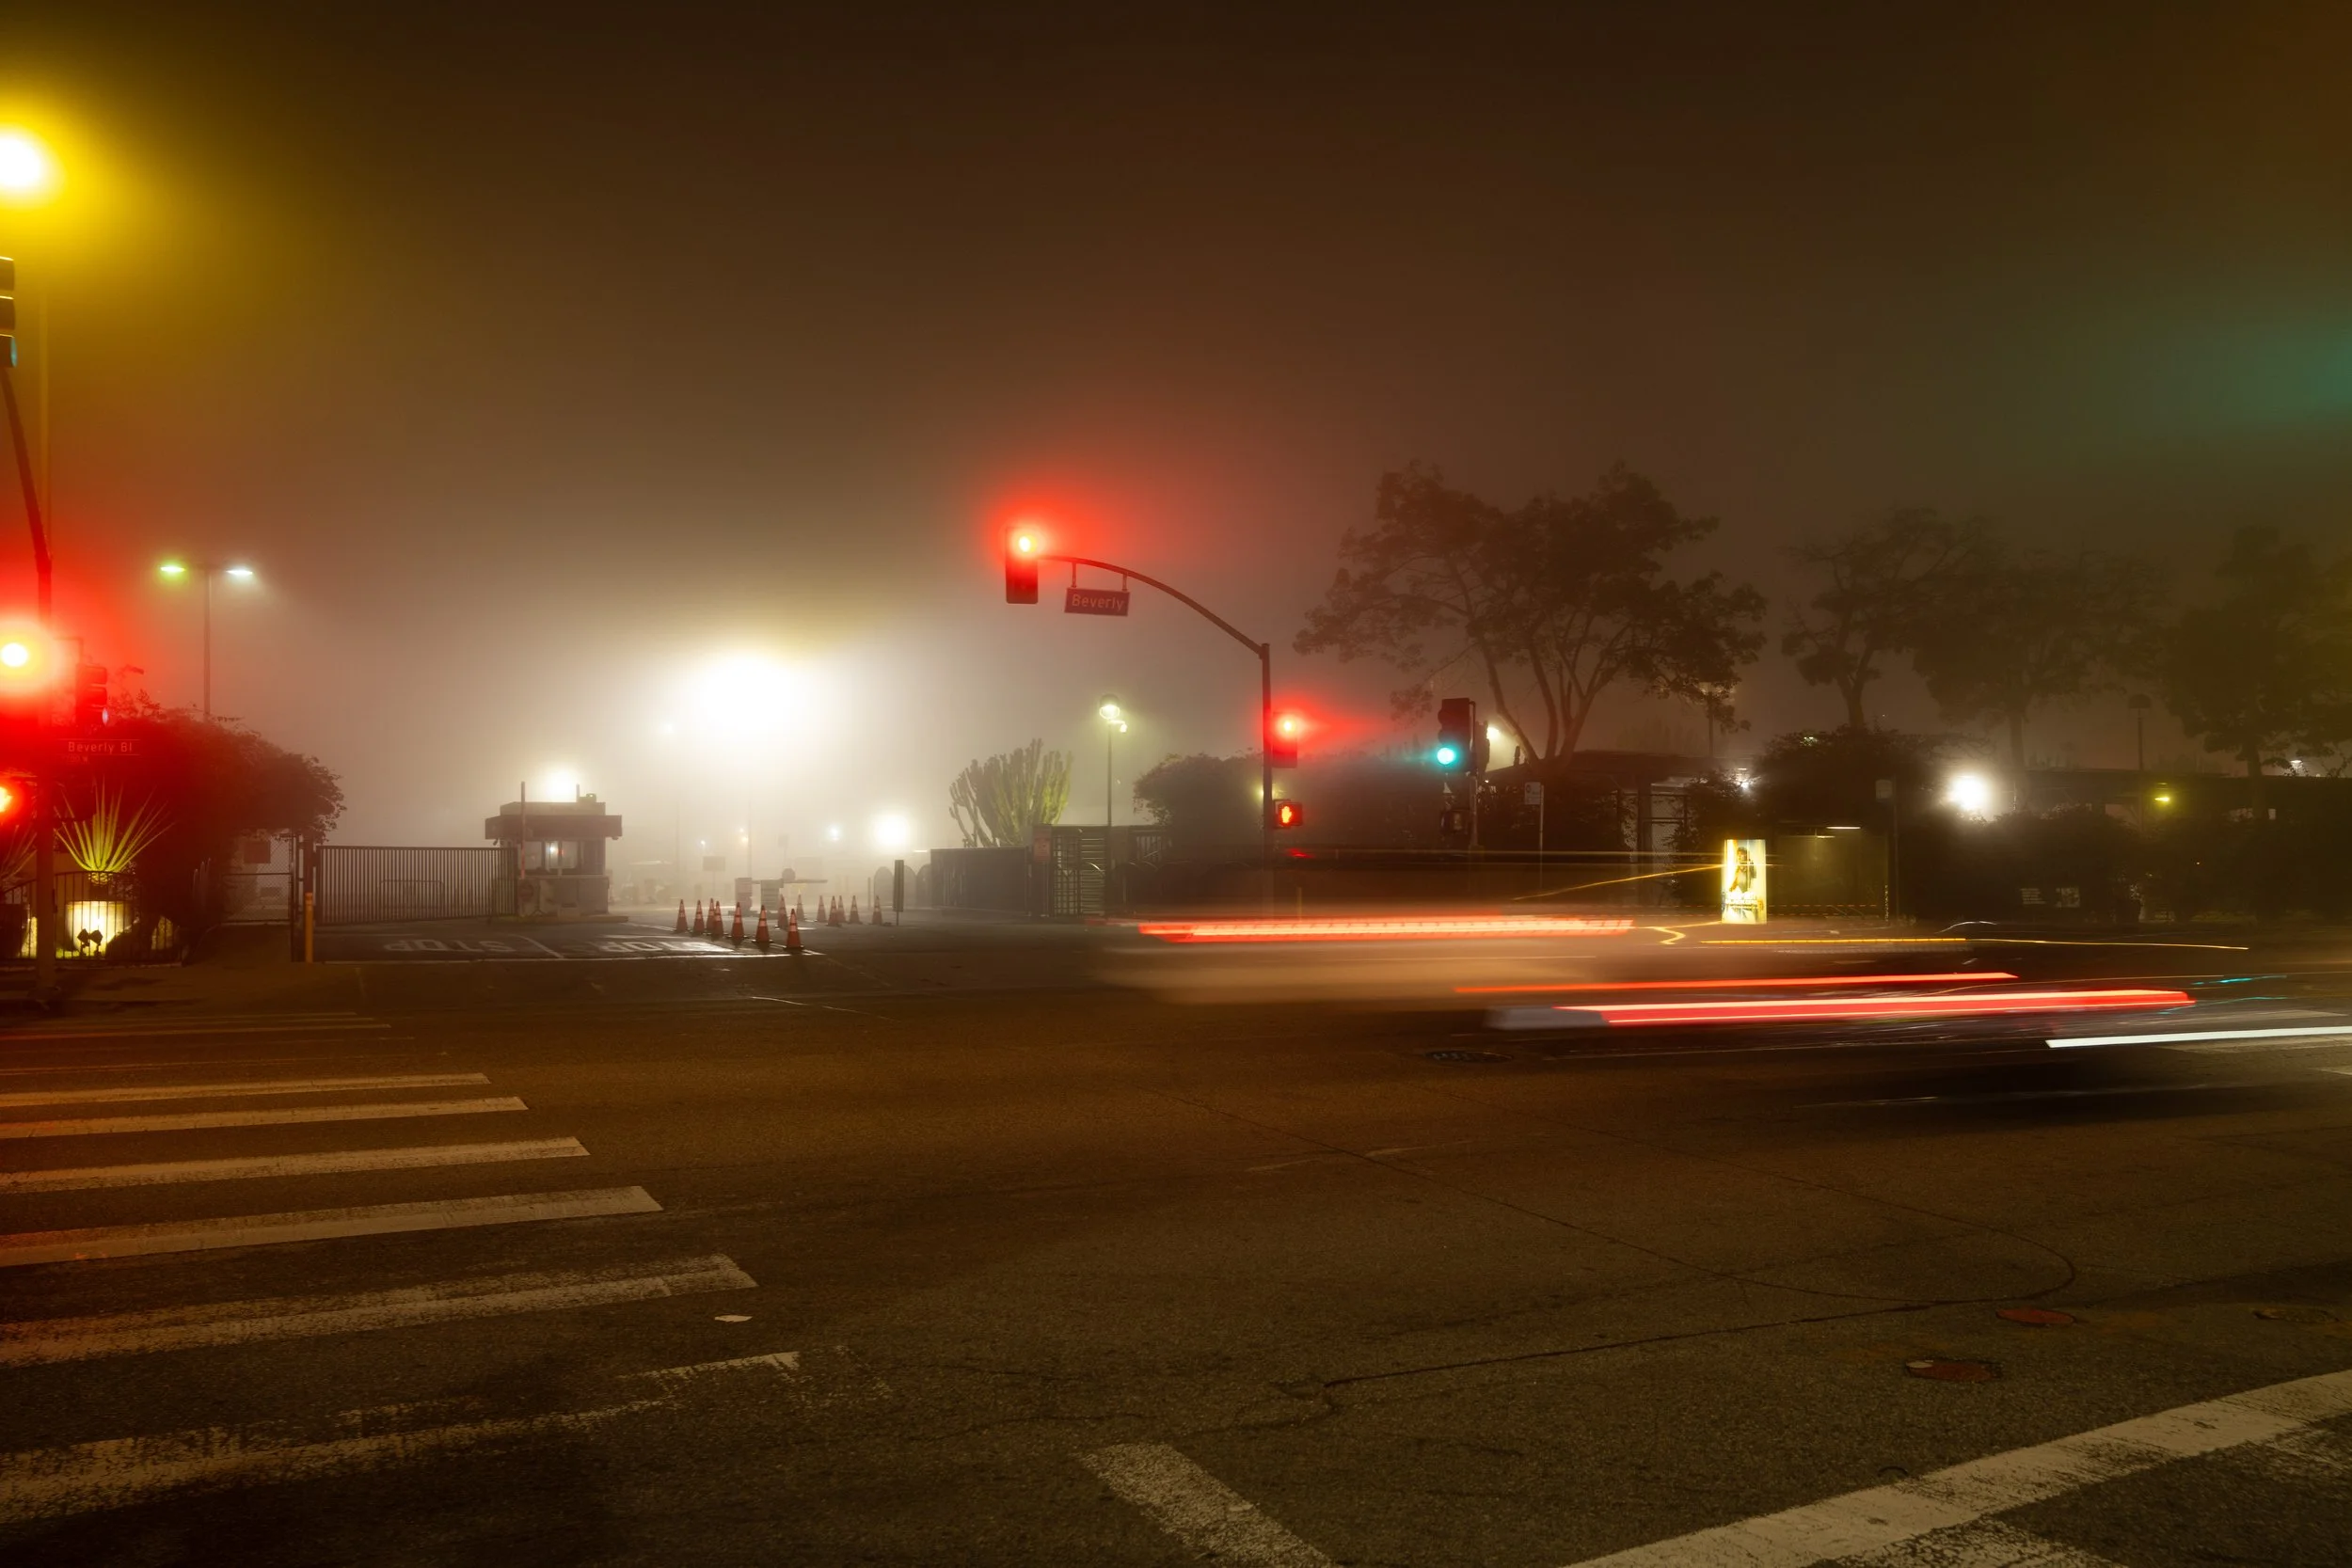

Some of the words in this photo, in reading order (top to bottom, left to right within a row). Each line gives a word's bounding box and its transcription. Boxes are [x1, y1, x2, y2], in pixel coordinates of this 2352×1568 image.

[1072, 594, 1124, 611] Beverly
[68, 741, 115, 754] Beverly
[384, 939, 516, 952] STOP
